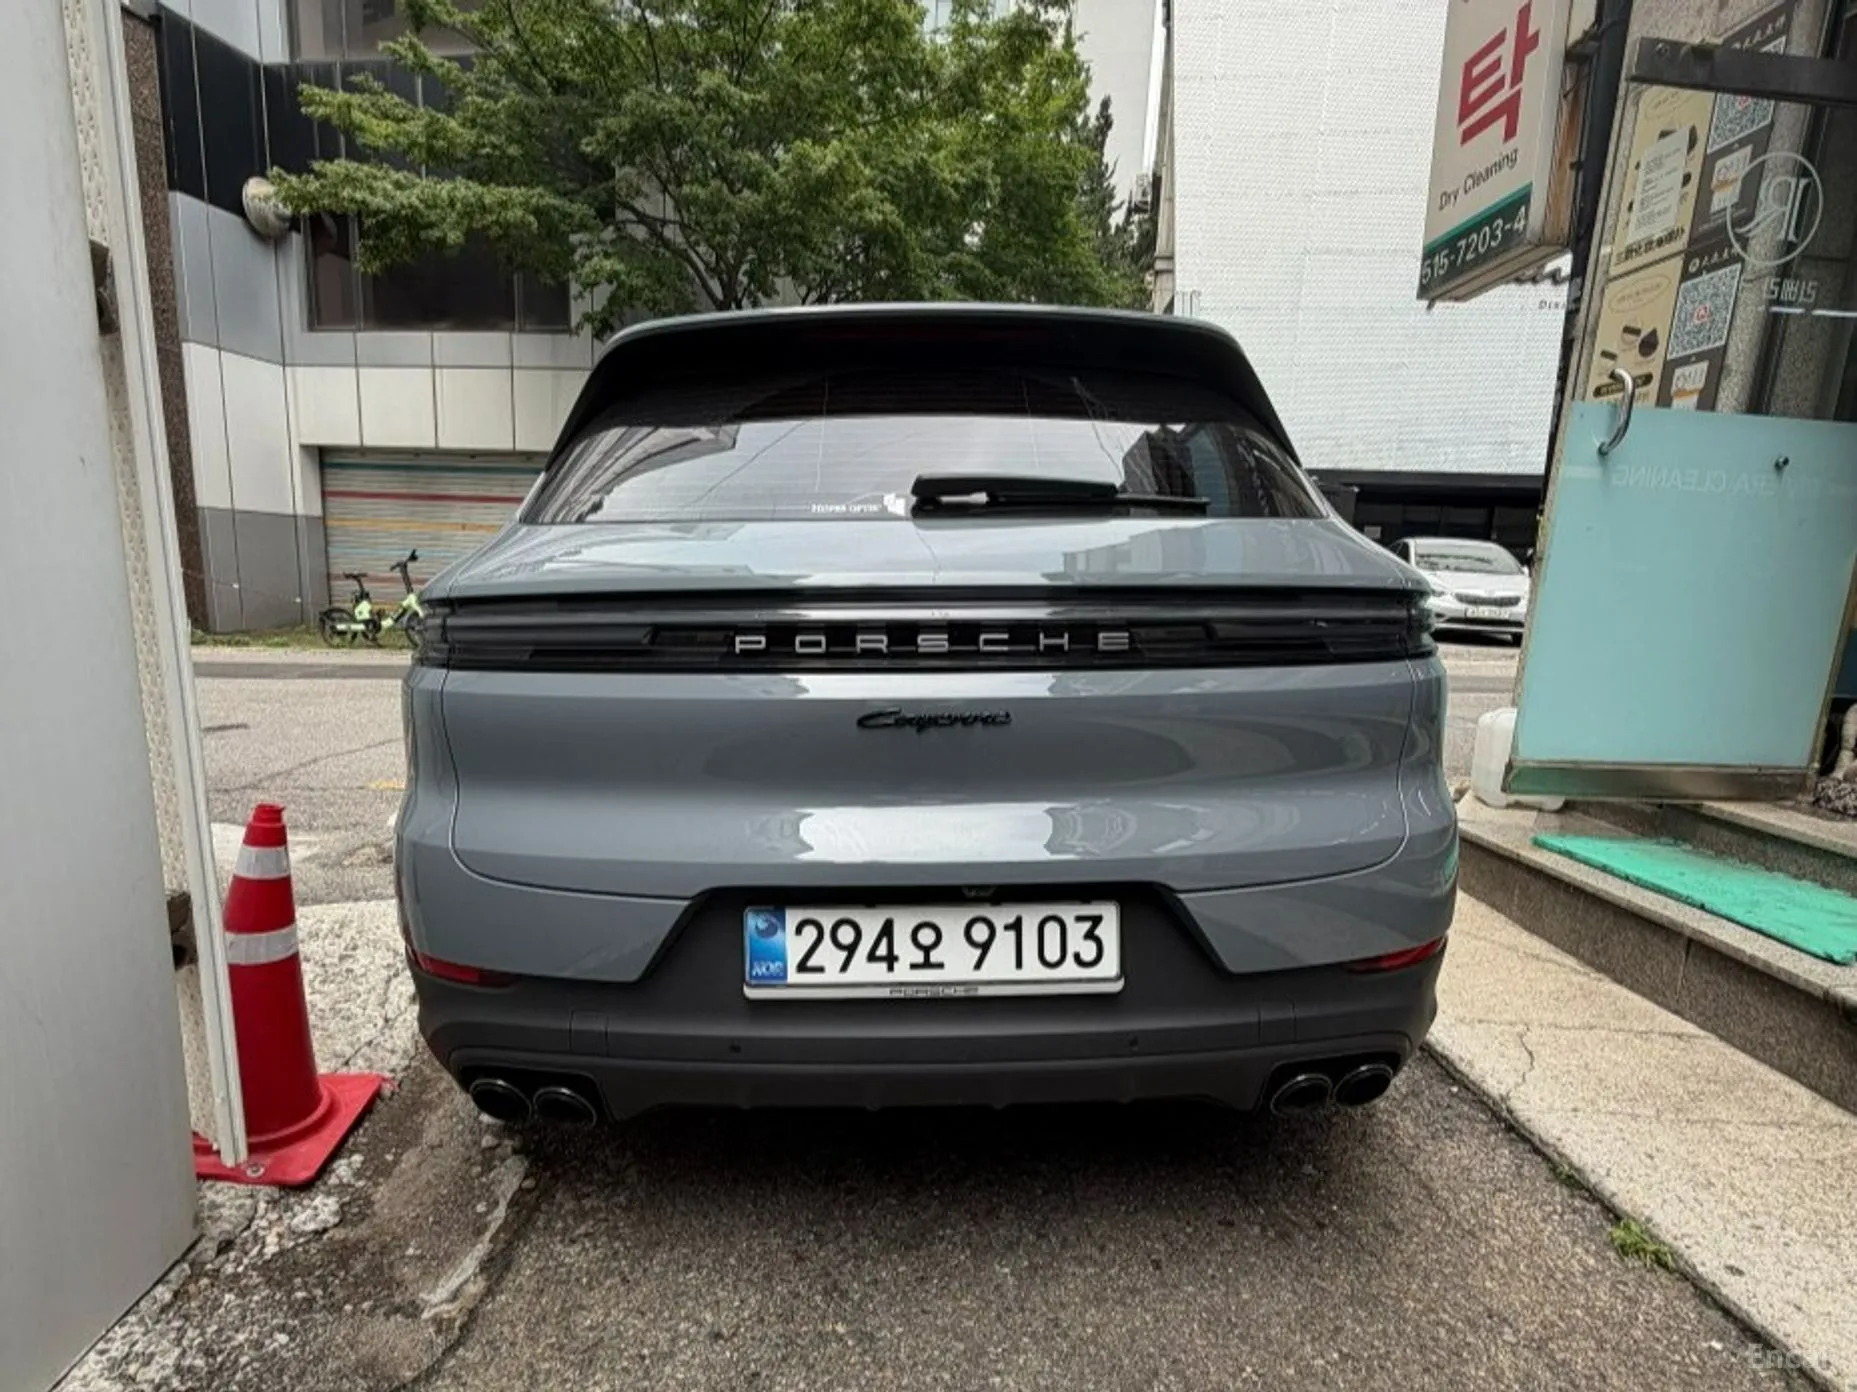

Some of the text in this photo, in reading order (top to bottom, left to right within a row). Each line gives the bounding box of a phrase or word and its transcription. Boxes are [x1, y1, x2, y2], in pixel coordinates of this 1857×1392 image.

[1438, 147, 1519, 212] Dry Cleaning
[734, 631, 1130, 654] PORSCHE
[856, 707, 1013, 735] Cayenne
[794, 914, 1105, 974] 294오 9103
[889, 986, 979, 996] PORSCHE
